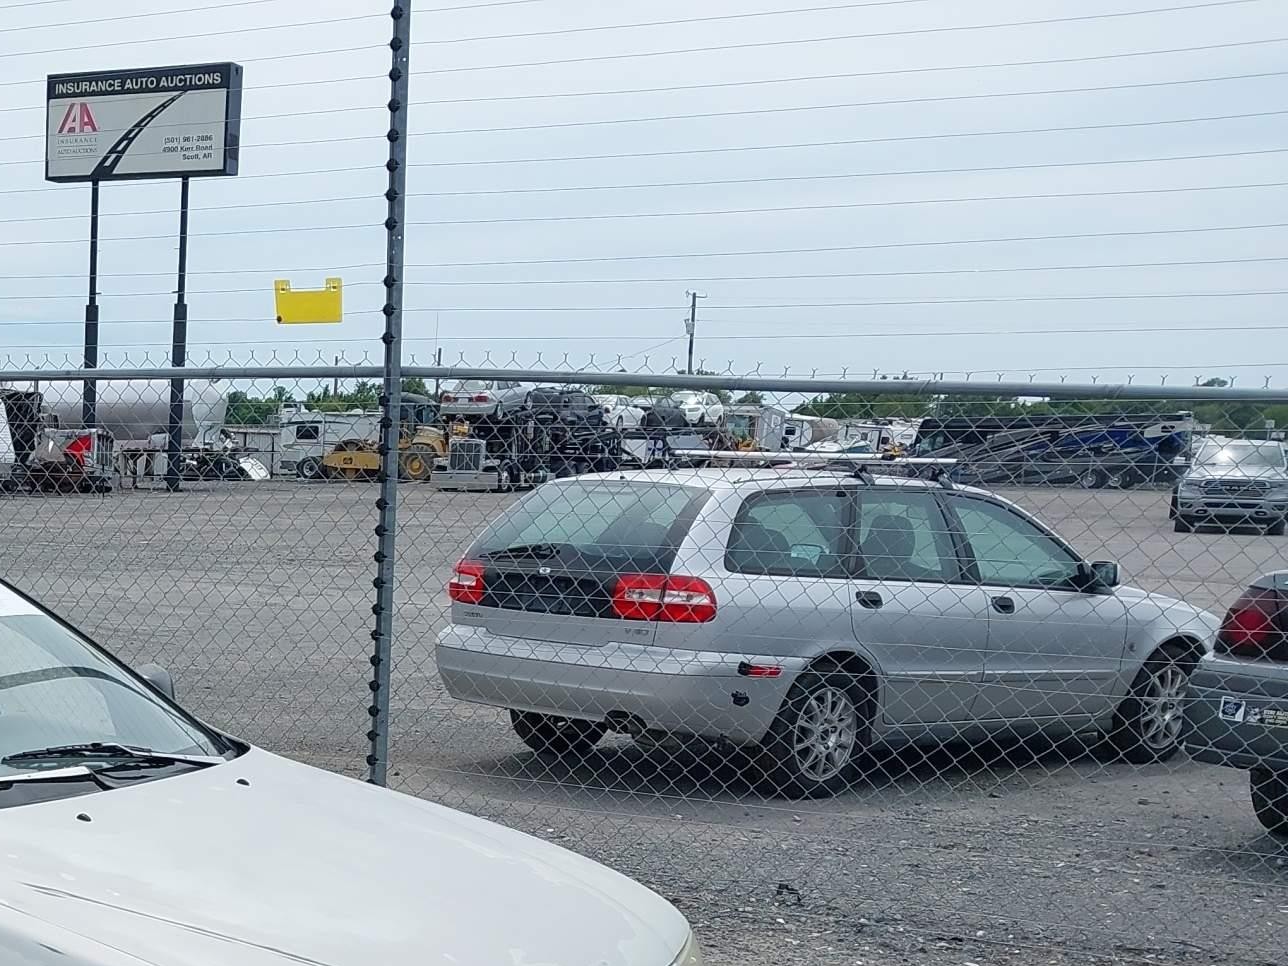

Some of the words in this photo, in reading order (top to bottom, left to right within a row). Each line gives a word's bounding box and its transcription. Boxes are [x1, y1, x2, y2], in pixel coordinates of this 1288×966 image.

[55, 79, 122, 95] INSURANCE
[124, 77, 157, 90] AUTO
[159, 72, 222, 88] AUCTIONS
